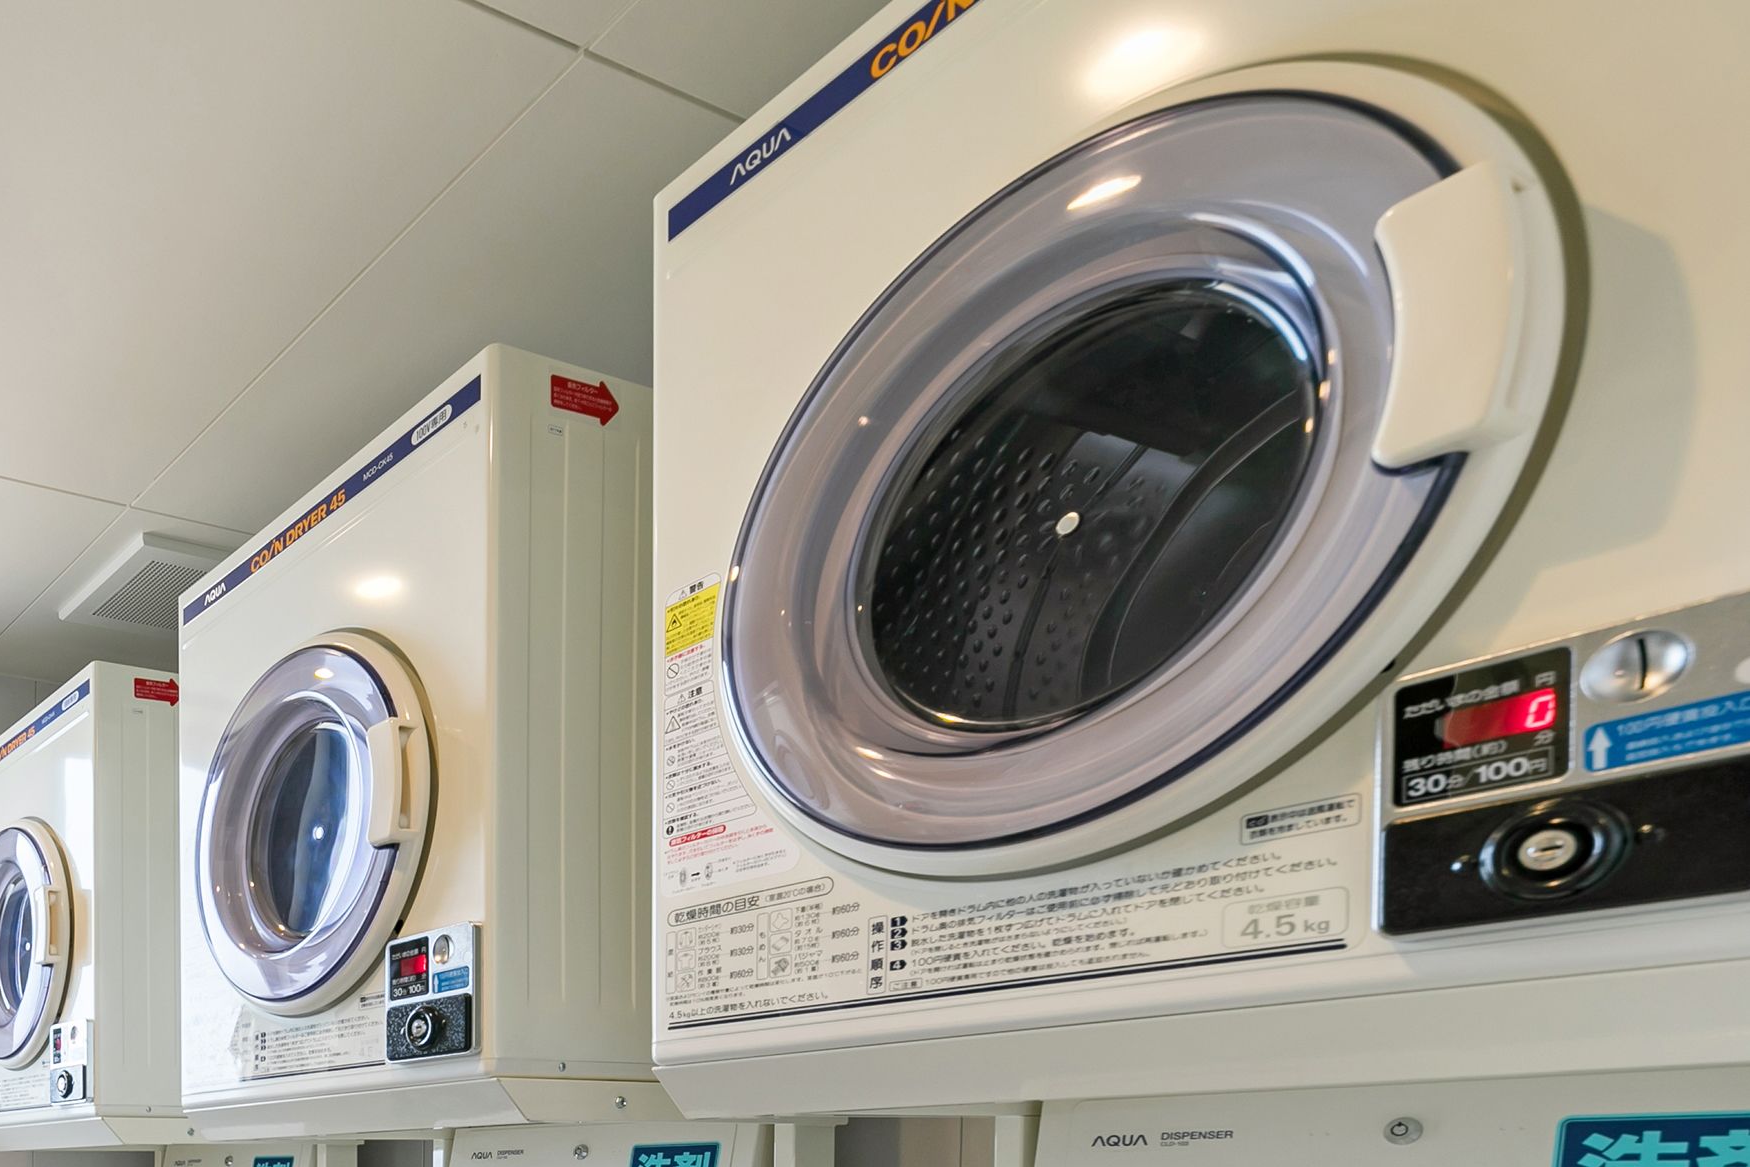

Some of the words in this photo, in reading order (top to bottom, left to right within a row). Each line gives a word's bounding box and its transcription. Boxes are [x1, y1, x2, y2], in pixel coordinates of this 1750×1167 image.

[730, 128, 791, 186] AQUA
[204, 582, 226, 606] AQUA
[286, 505, 327, 546] DRYER
[330, 489, 346, 511] 45
[1535, 671, 1556, 687] 円
[1525, 694, 1556, 728] 0
[1534, 730, 1556, 746] 分
[674, 895, 760, 924] 乾燥時間の目安
[1241, 914, 1296, 939] 4.5
[1303, 919, 1331, 934] kg
[869, 921, 886, 990] 操作順序
[1091, 1134, 1148, 1148] AQUA
[1160, 1130, 1234, 1141] DISPENSER
[471, 1151, 493, 1160] AQUA
